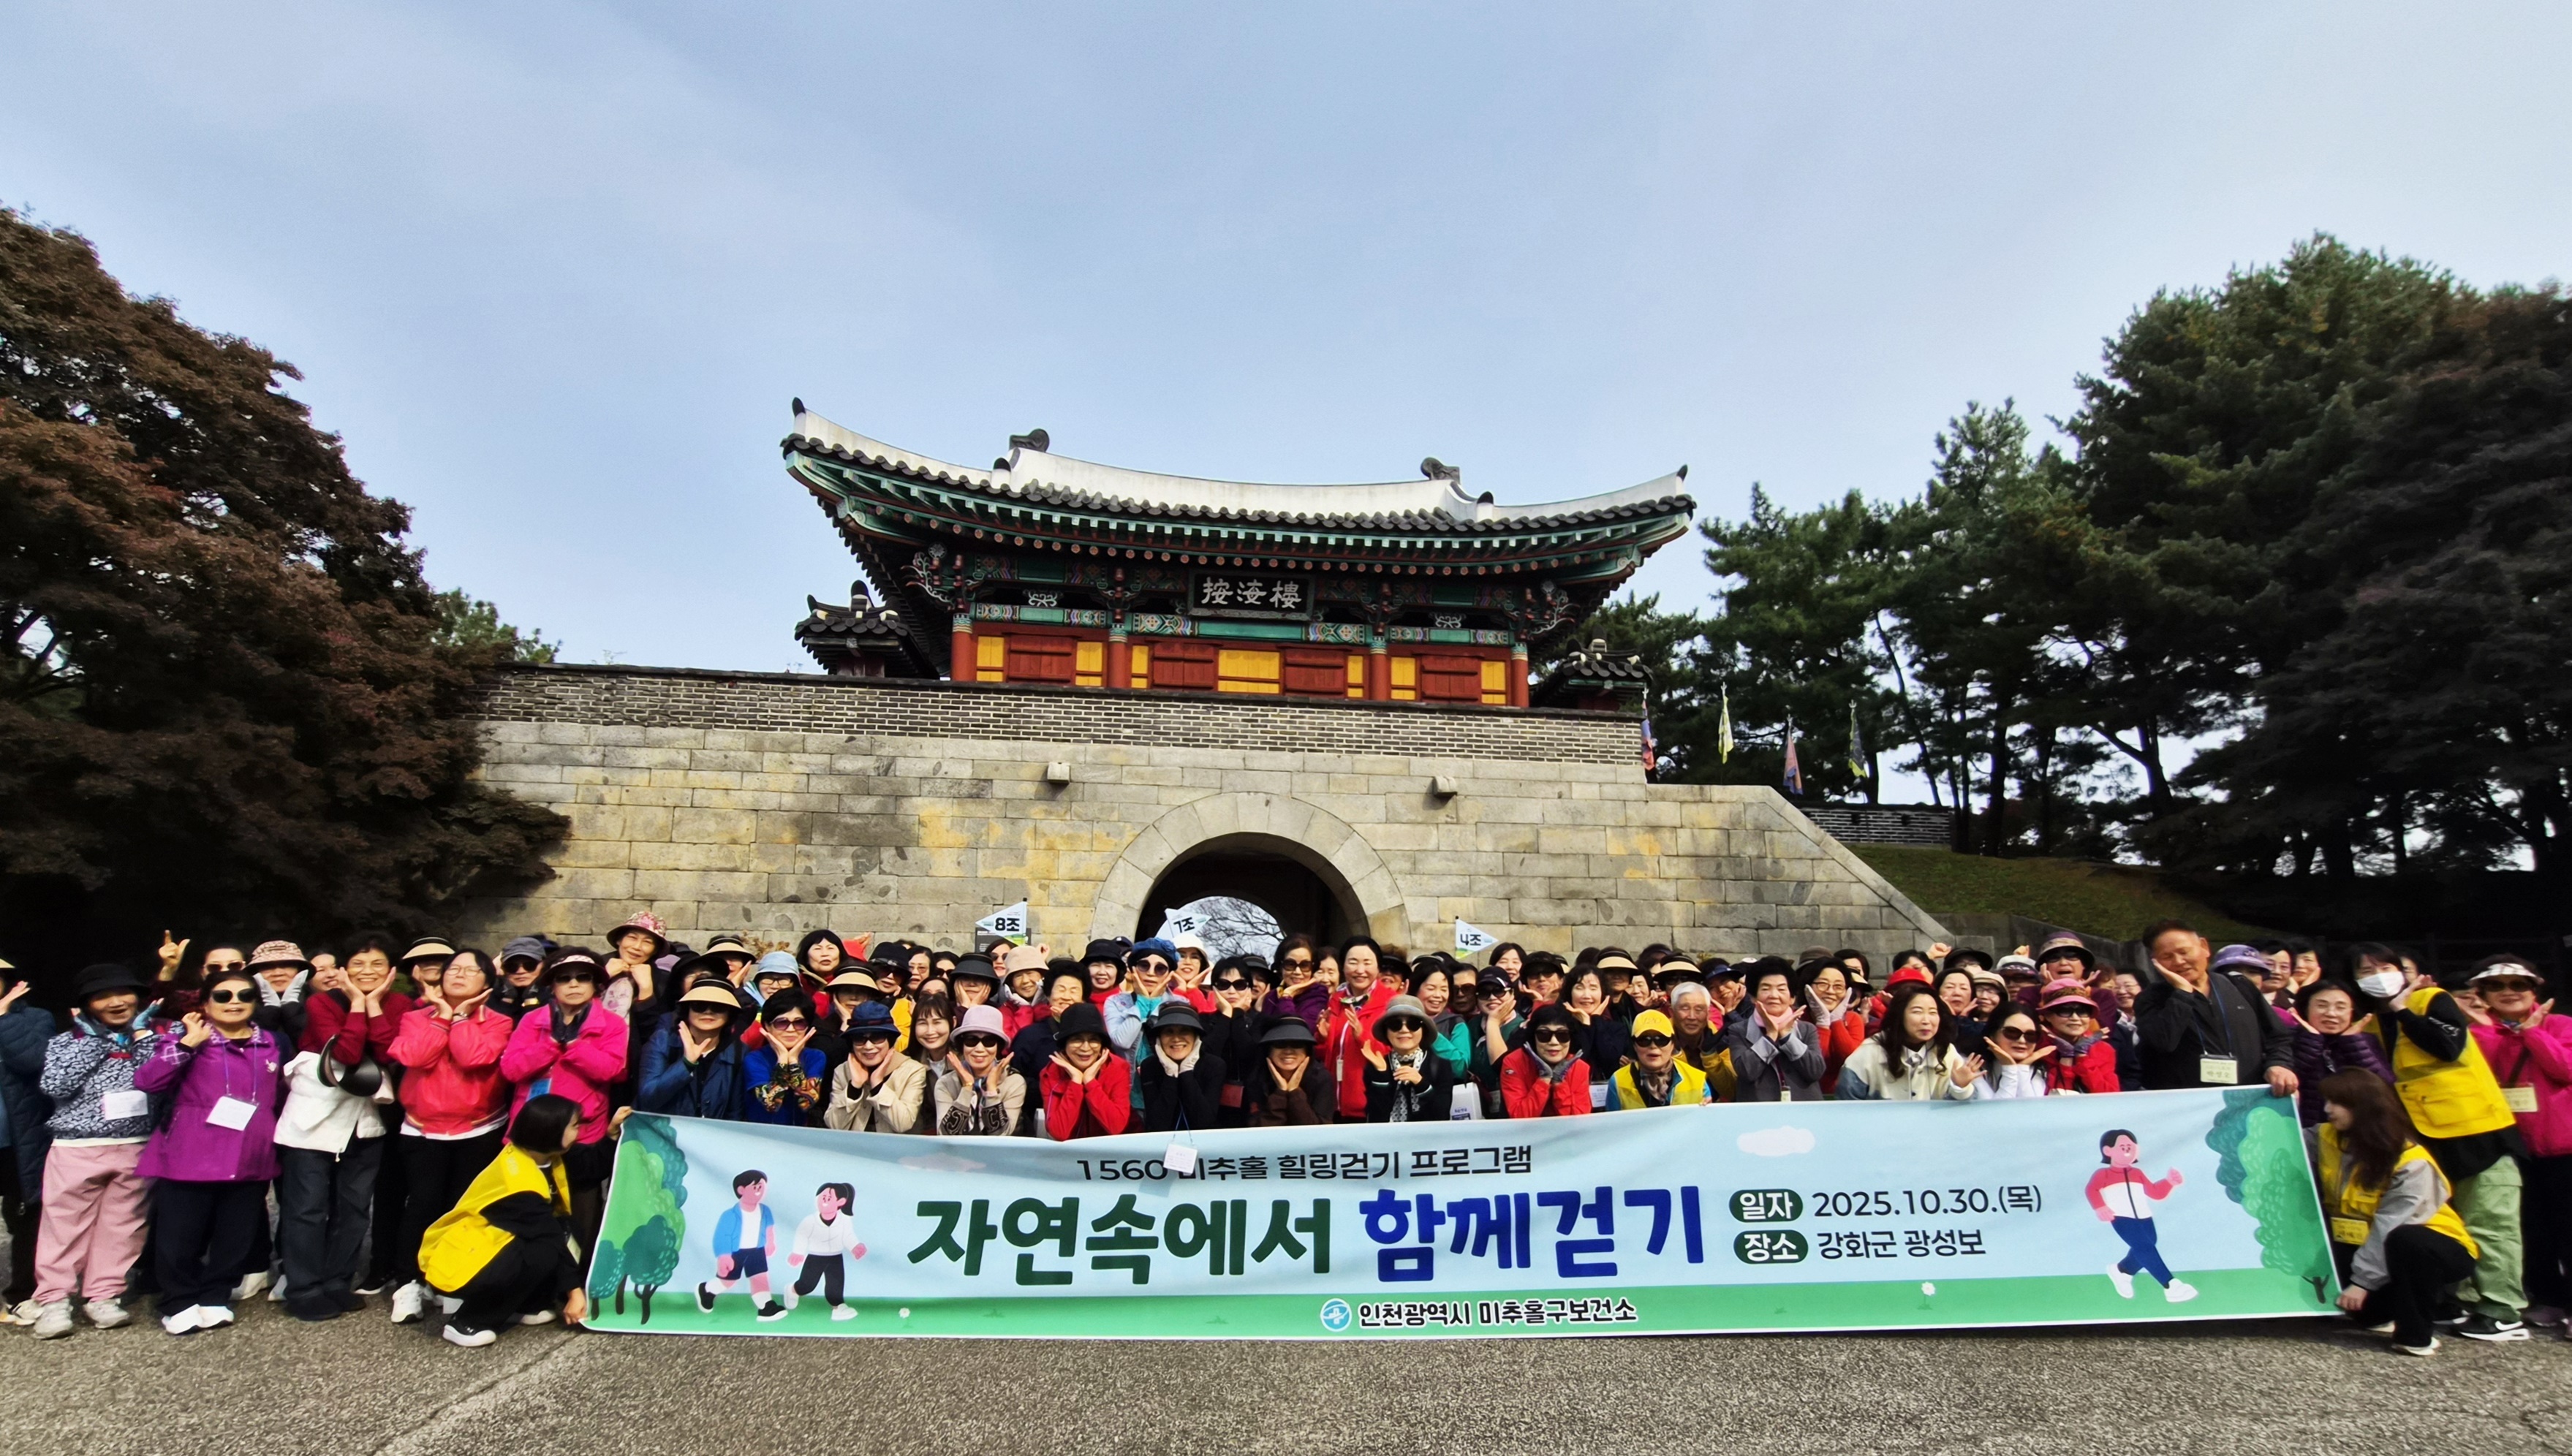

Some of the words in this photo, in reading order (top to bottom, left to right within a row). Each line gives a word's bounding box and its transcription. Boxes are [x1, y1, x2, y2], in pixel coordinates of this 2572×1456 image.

[1201, 576, 1302, 609] 按海樓
[994, 917, 1021, 932] 8조
[1460, 933, 1481, 946] 4조
[1077, 1159, 1168, 1180] 1560
[1277, 1152, 1399, 1180] 힐링걷기
[1410, 1145, 1532, 1178] 프로그램
[1739, 1191, 1794, 1221] 일자
[1812, 1185, 2041, 1218] 2025.10.30.(목)
[907, 1194, 1331, 1286] 자연속에서
[1358, 1186, 1704, 1283] 함께걷기
[1744, 1232, 1799, 1262] 장소
[1817, 1232, 1898, 1260] 강화군
[1904, 1229, 1987, 1258] 광성보
[1359, 1303, 1471, 1327] 인천광역시
[1479, 1298, 1638, 1324] 미추홀구보건소
